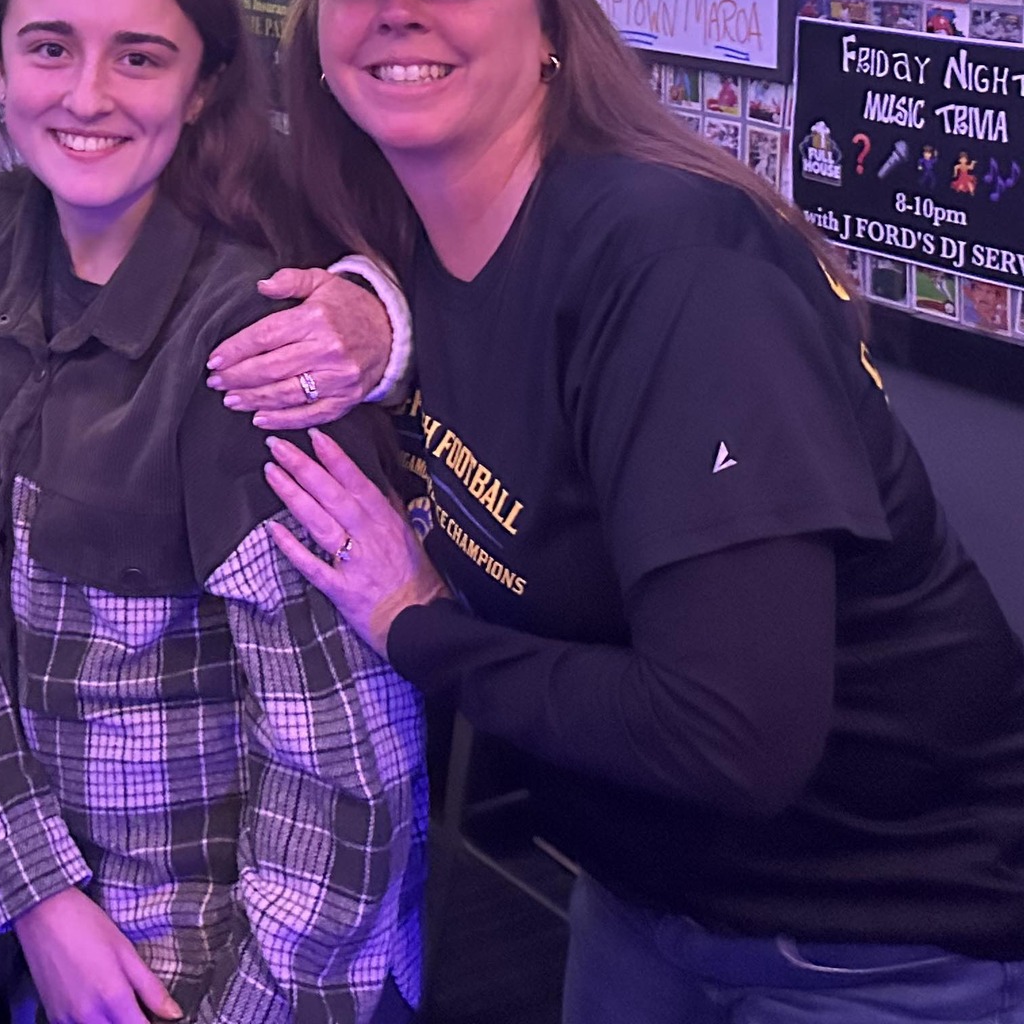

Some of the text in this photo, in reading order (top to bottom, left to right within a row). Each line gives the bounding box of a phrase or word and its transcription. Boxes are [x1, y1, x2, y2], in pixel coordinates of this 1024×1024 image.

[863, 90, 1009, 144] MUSIC TRIVIA
[802, 158, 841, 179] HOUSE
[807, 146, 835, 164] FULL
[895, 192, 968, 226] 8-10pm
[803, 206, 839, 232] with
[839, 214, 852, 240] J
[855, 216, 935, 255] FORD'S
[940, 236, 967, 268] DJ
[432, 429, 524, 536] FOOTBALL
[446, 516, 527, 596] CHAMPIONS
